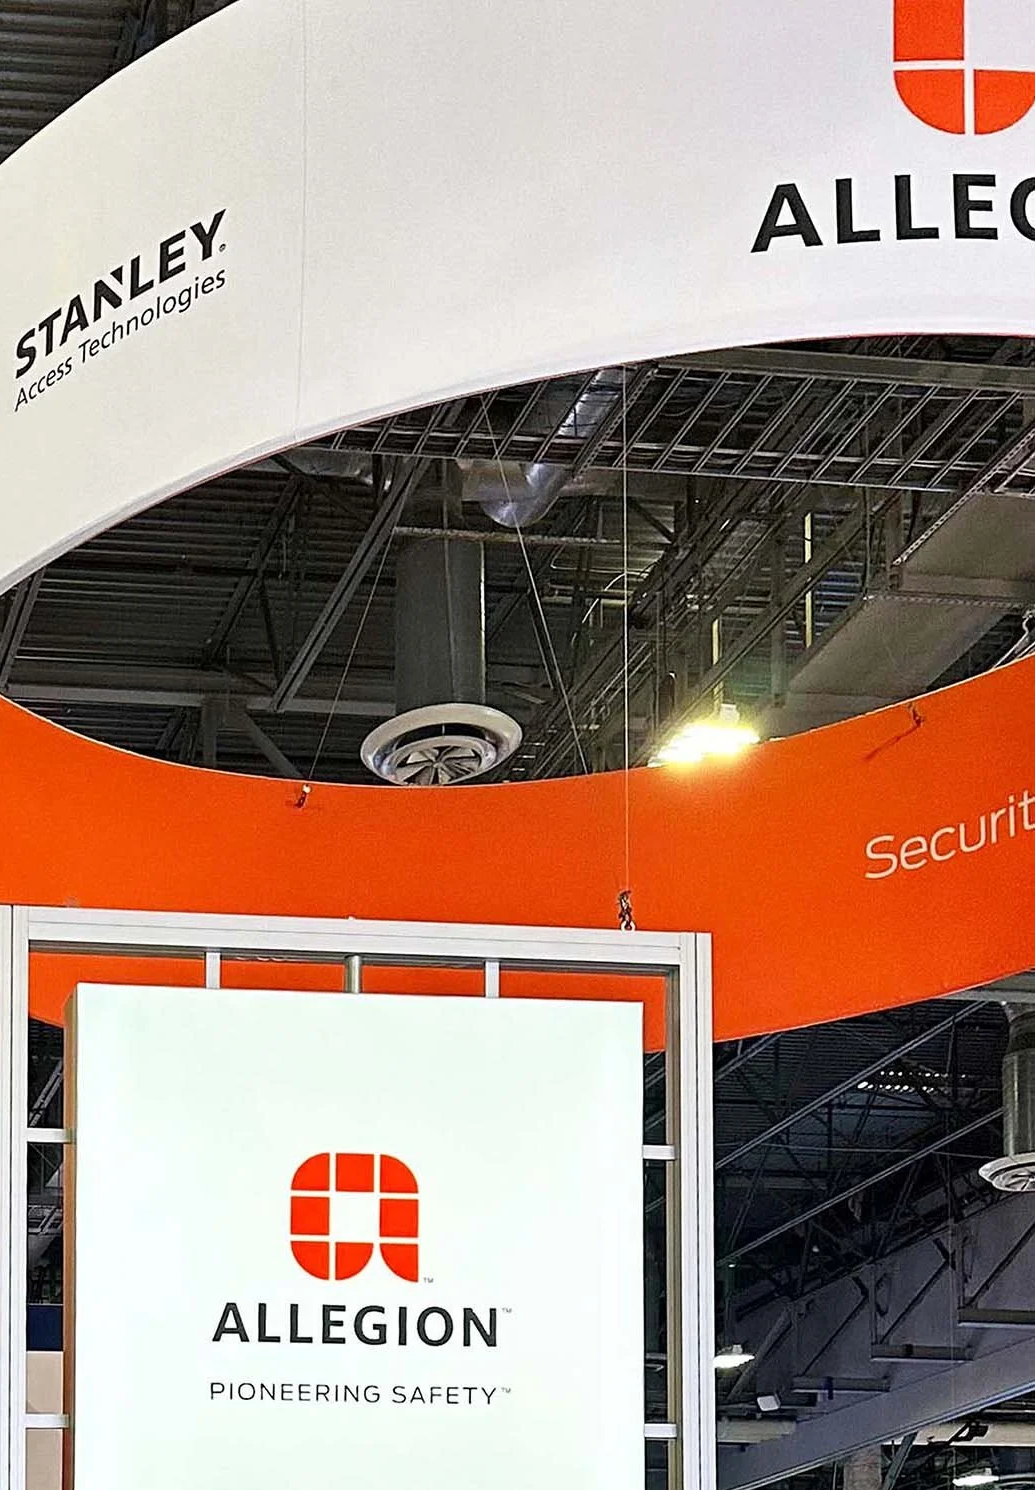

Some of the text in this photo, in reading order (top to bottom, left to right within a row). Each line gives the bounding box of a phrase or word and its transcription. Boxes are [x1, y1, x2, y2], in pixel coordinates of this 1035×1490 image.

[13, 267, 227, 413] Access Technologies
[864, 789, 1035, 880] Securit
[209, 1381, 382, 1404] PIONEERING
